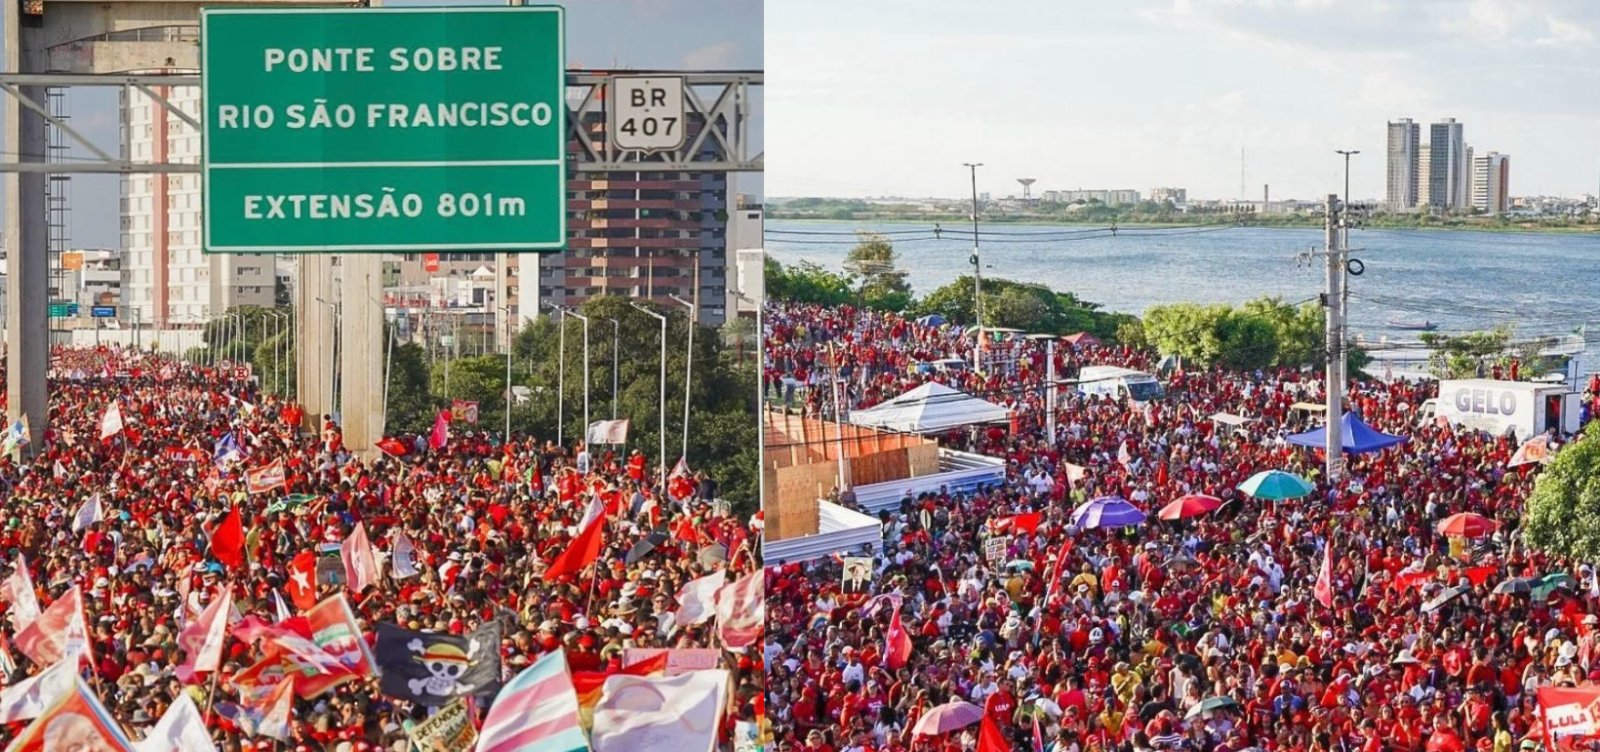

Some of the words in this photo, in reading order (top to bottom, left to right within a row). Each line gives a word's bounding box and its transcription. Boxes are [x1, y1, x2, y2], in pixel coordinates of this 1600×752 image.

[266, 47, 374, 72] PONTE
[389, 46, 503, 71] SOBRE
[631, 88, 666, 107] BR
[219, 104, 274, 129] RIO
[286, 98, 355, 128] SÃO
[367, 102, 552, 128] FRANCISCO
[620, 116, 677, 136] 407
[244, 187, 423, 219] EXTENSÃO
[437, 192, 525, 217] 801m
[1455, 388, 1516, 415] GELO
[1548, 713, 1587, 729] LULA
